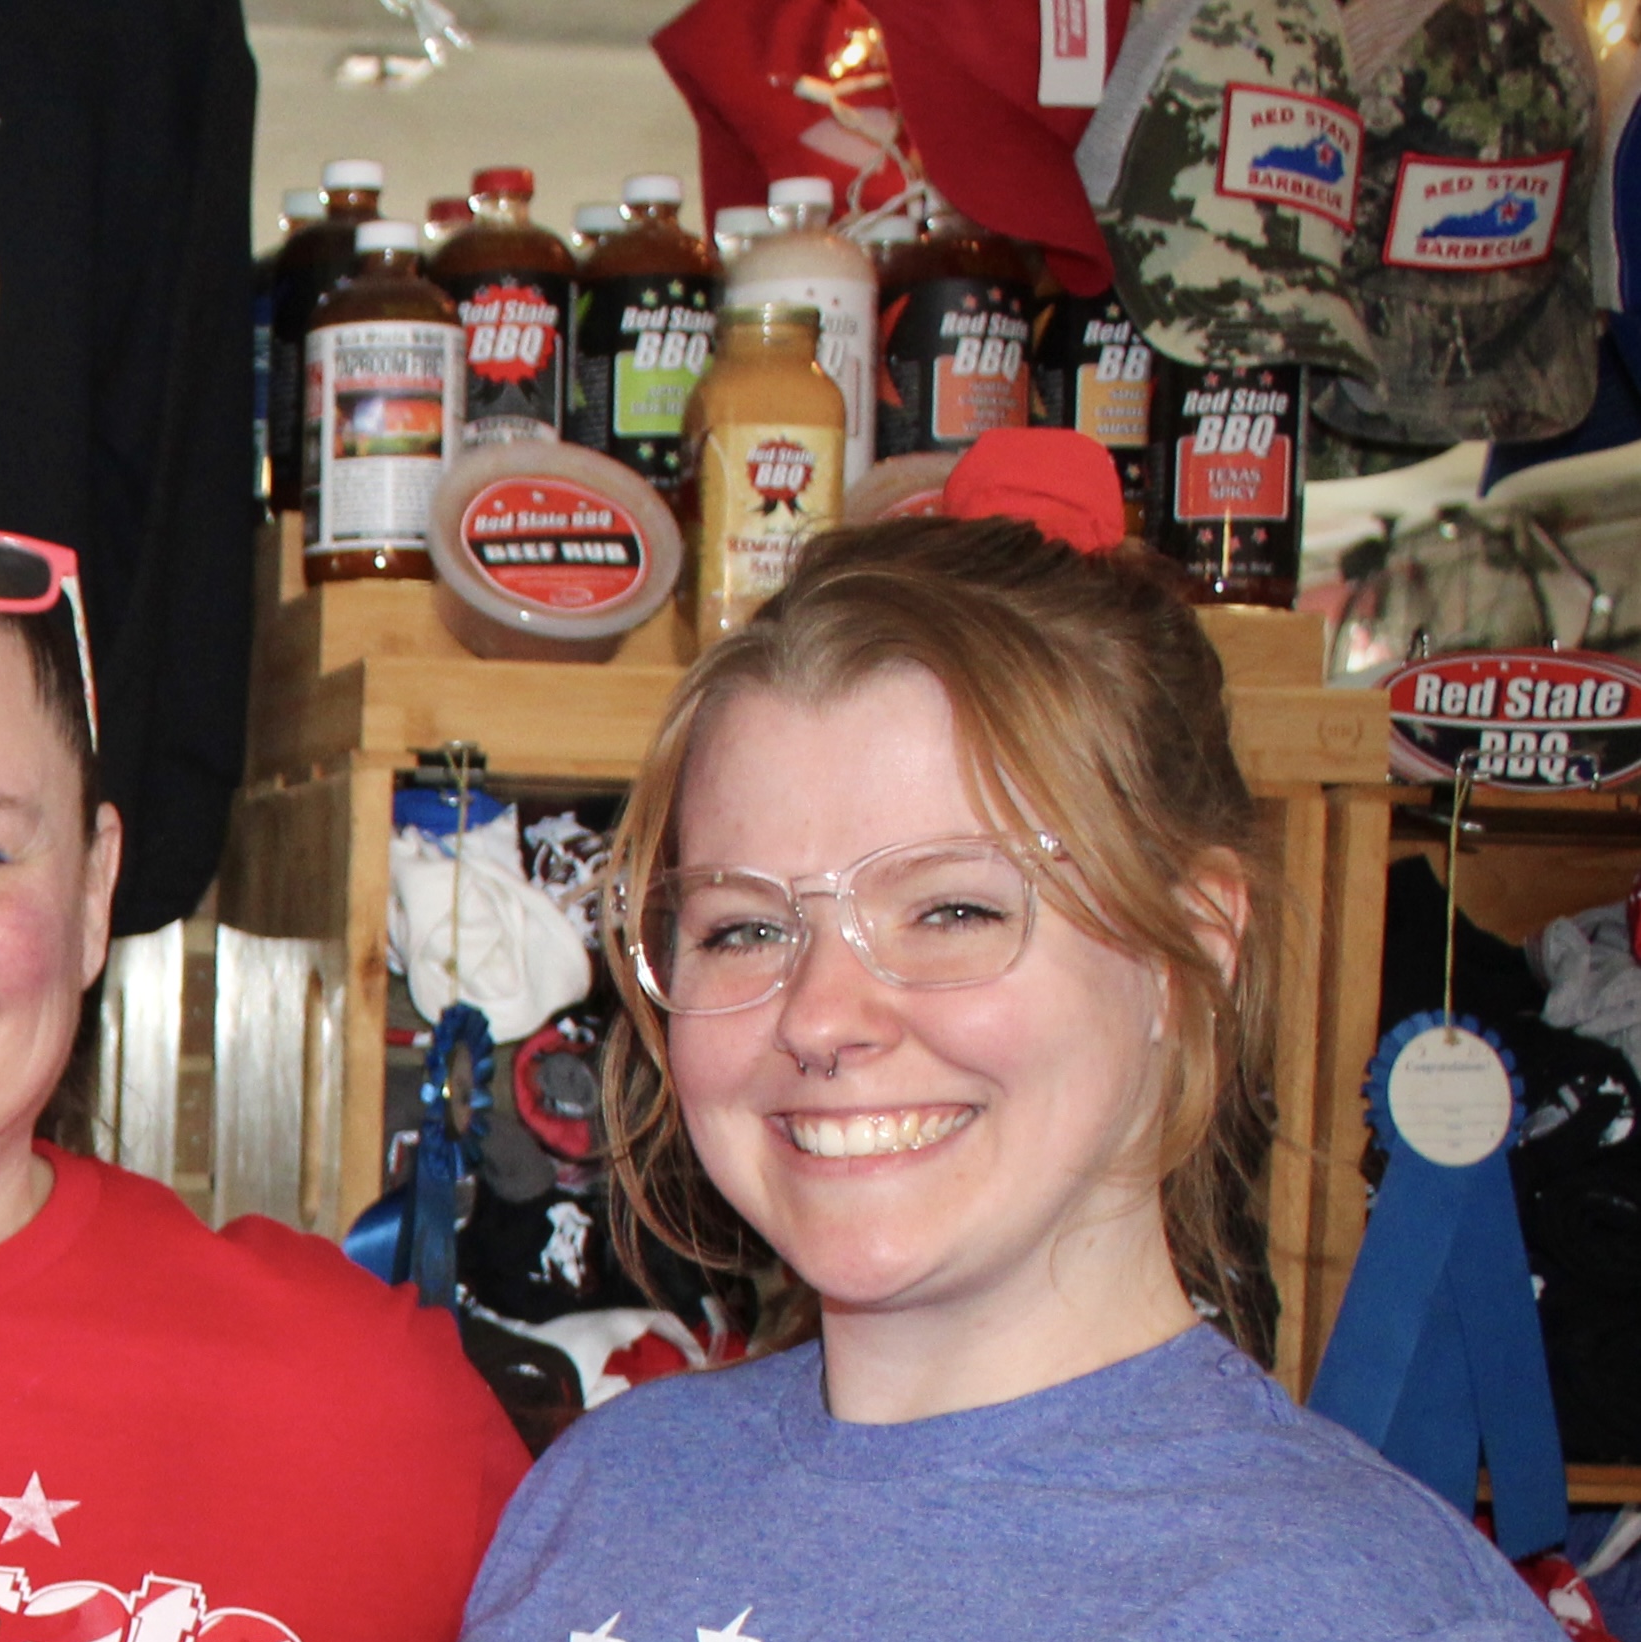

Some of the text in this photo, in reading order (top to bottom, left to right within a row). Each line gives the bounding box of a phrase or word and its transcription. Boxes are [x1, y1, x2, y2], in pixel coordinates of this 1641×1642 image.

[1251, 108, 1351, 153] RED STATE
[1248, 169, 1343, 209] BARBECUE
[1424, 174, 1549, 200] RED STATE
[1416, 237, 1533, 259] BARBECUE
[502, 299, 559, 326] State
[620, 306, 668, 334] Red
[940, 311, 1029, 341] Red State
[468, 323, 546, 367] BBQ
[1083, 320, 1132, 345] Red
[633, 331, 709, 376] BBQ
[952, 337, 1023, 382] BBQ
[1096, 345, 1151, 382] BB
[1183, 388, 1289, 416] Red State
[1193, 414, 1277, 459] BBQ
[754, 462, 806, 492] BBQ
[1207, 467, 1262, 484] TEXAS
[1209, 485, 1259, 500] SPICY
[474, 510, 614, 533] Red State BBQ
[483, 541, 629, 563] BEEF RUB
[1414, 672, 1626, 720] Red State
[1477, 730, 1570, 784] BBQ
